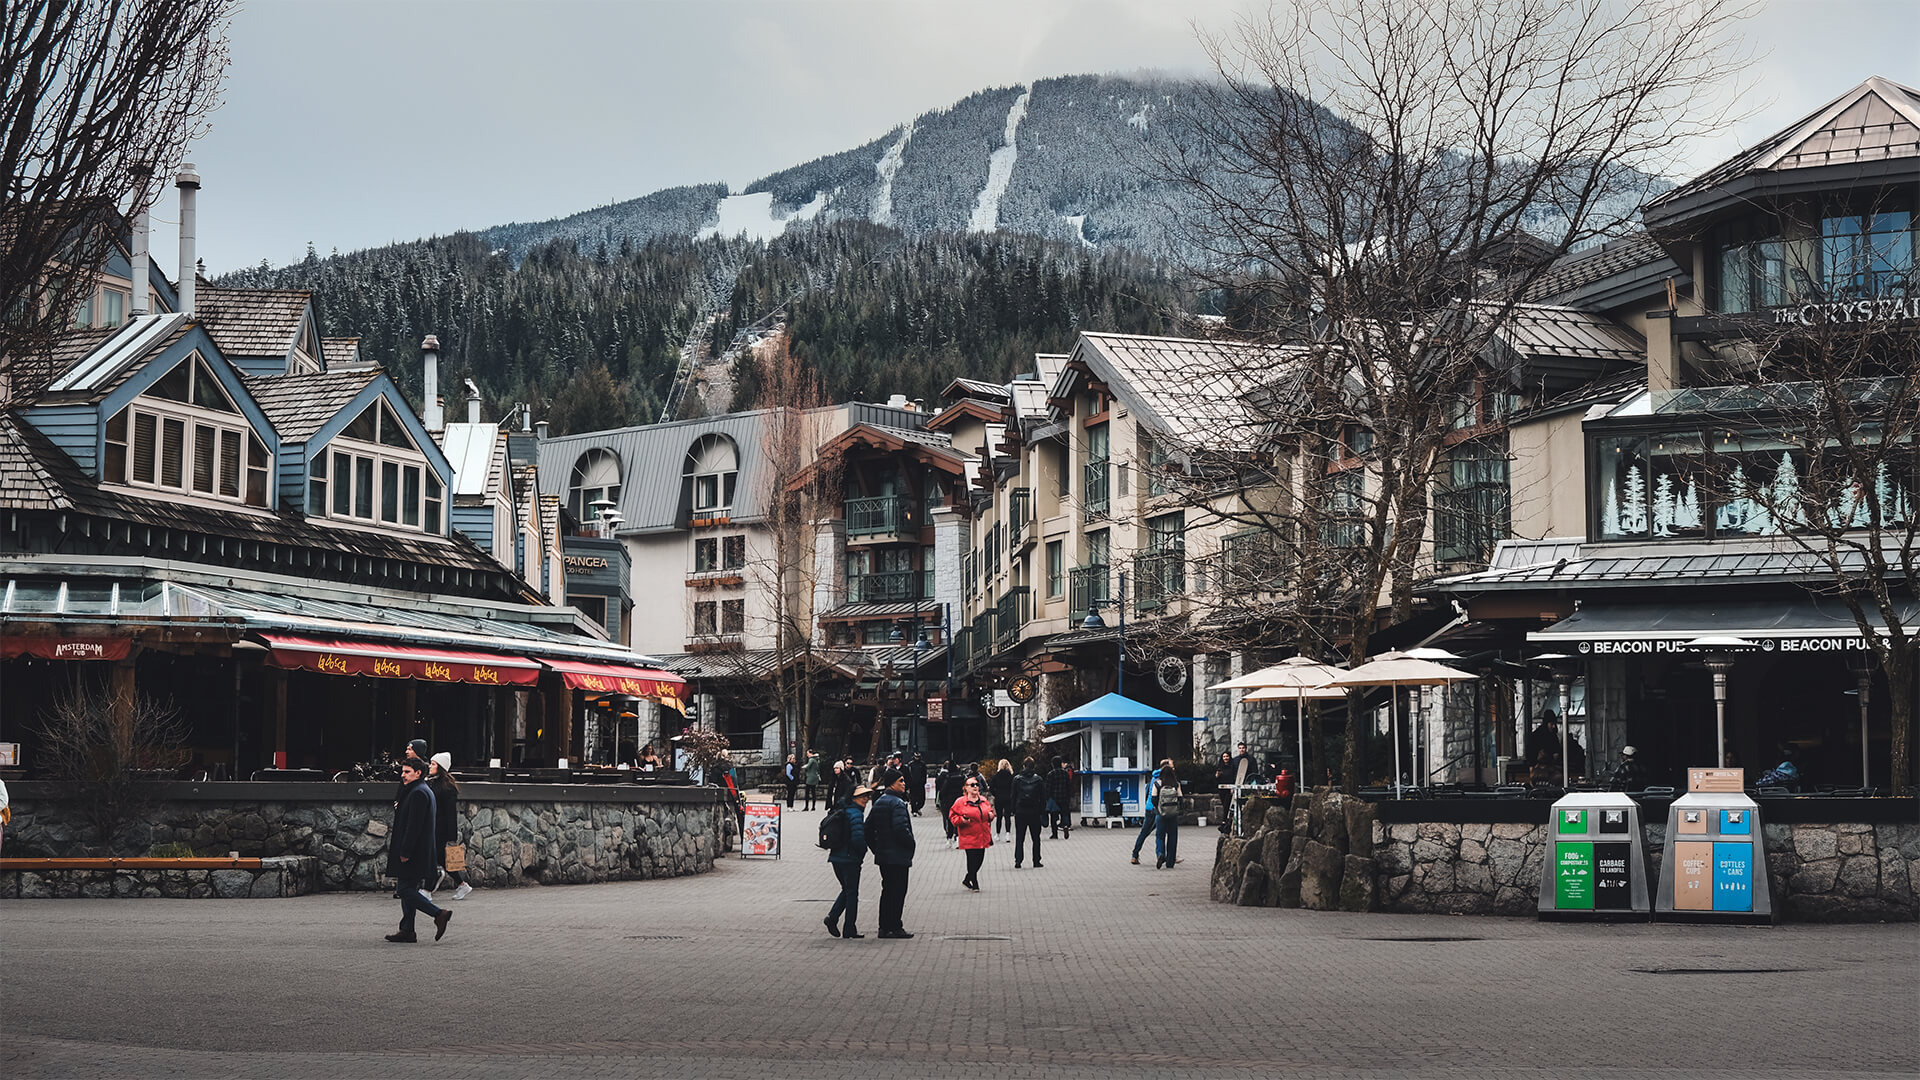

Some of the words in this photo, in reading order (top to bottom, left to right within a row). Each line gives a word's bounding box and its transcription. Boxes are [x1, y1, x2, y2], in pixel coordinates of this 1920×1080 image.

[1772, 308, 1798, 323] The
[564, 556, 608, 567] PANGEA
[55, 643, 103, 657] AMSTERDAM
[1594, 641, 1652, 653] BEACON
[1780, 638, 1842, 651] BEACON
[1685, 867, 1702, 875] CUPS
[1727, 868, 1744, 876] CANS
